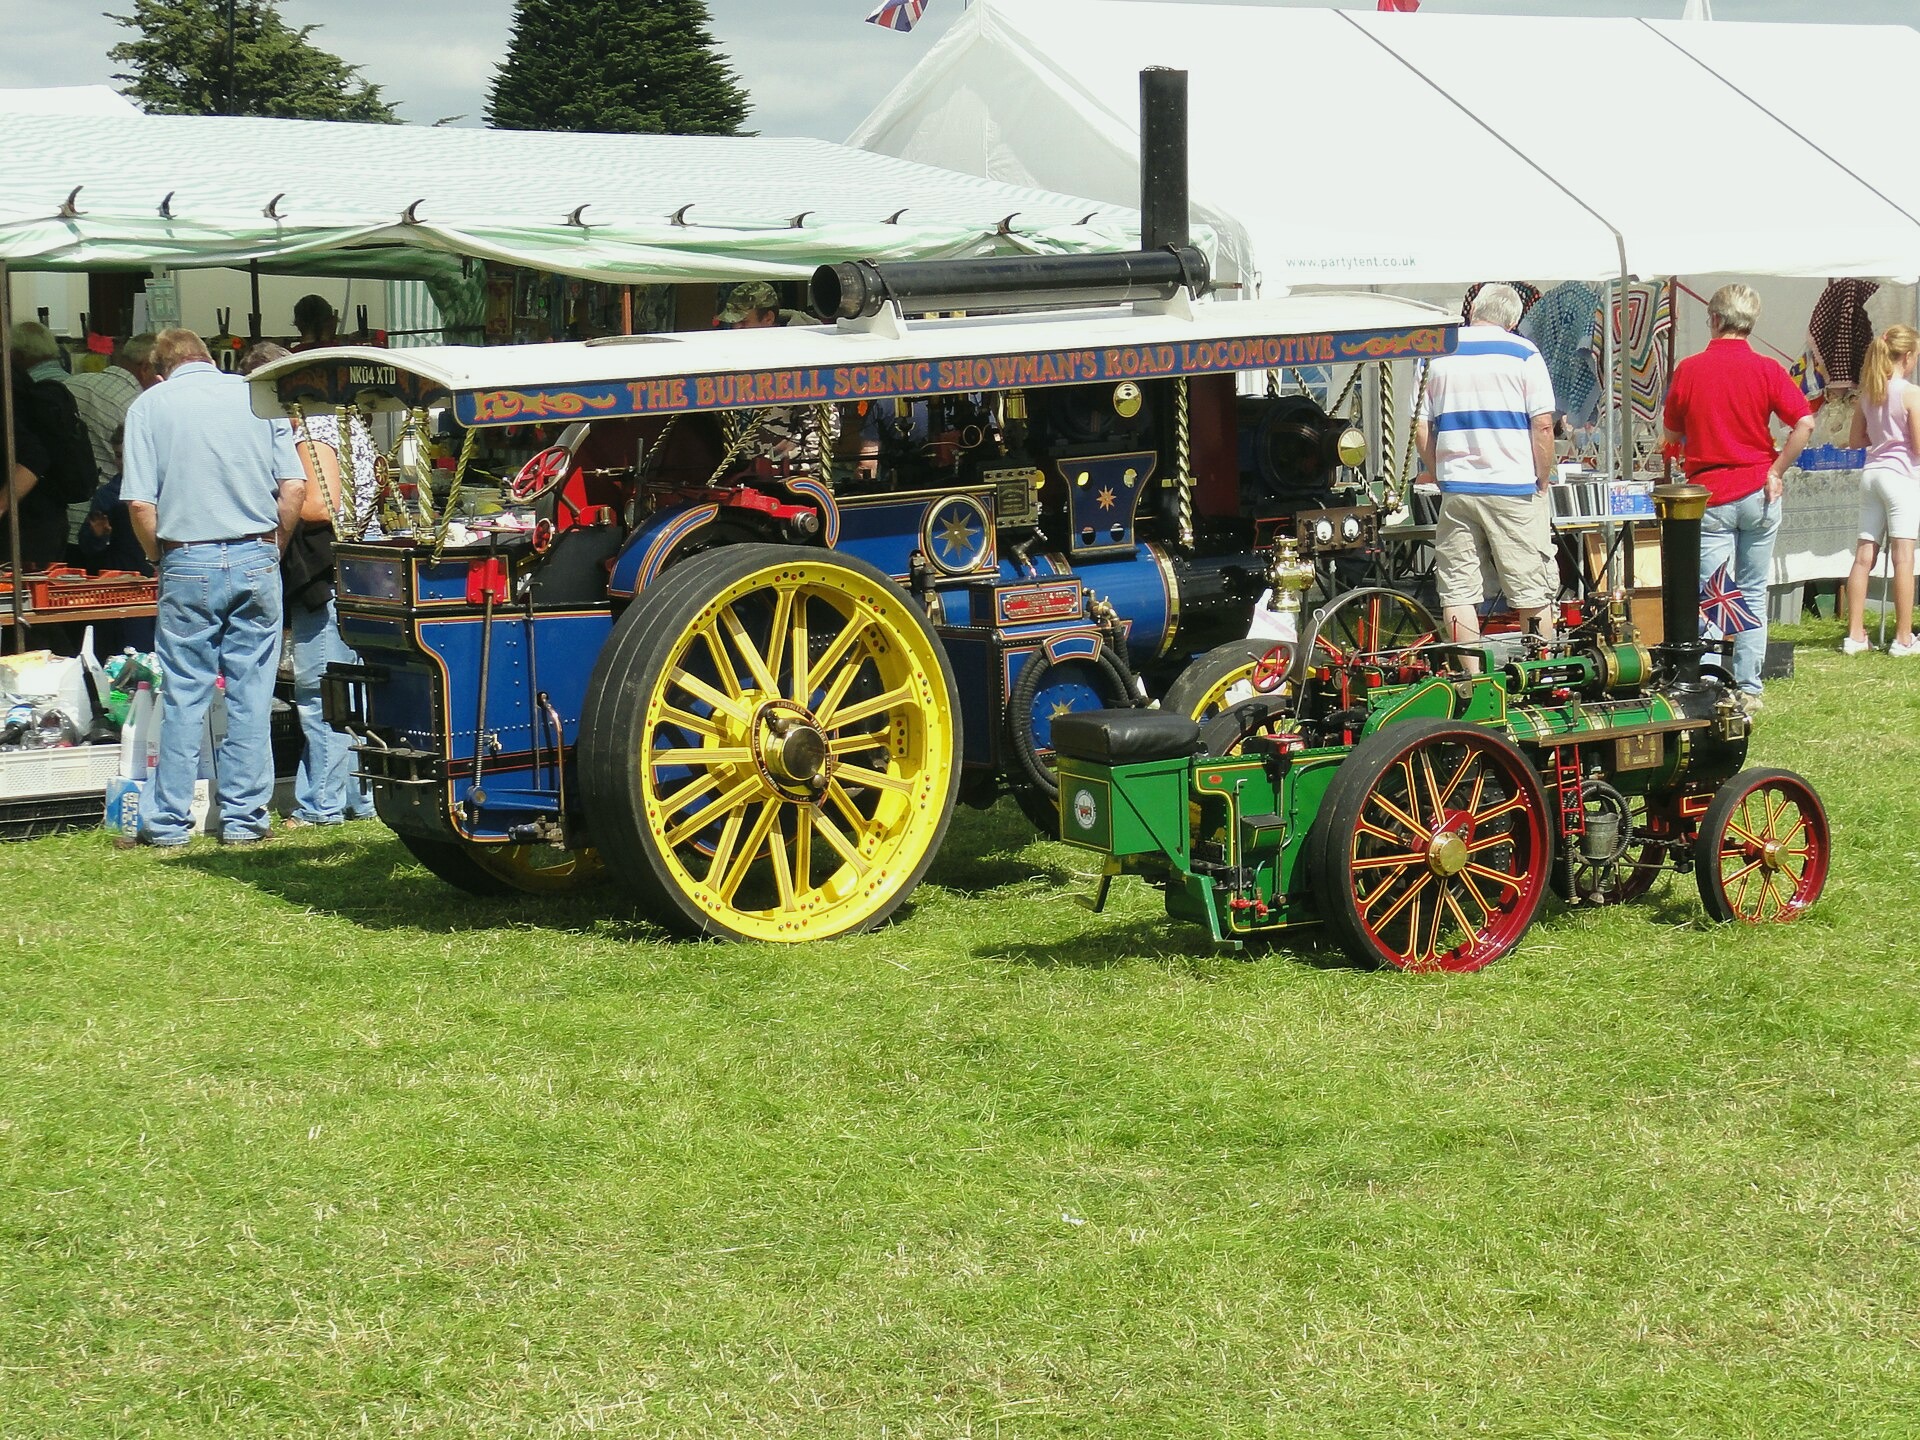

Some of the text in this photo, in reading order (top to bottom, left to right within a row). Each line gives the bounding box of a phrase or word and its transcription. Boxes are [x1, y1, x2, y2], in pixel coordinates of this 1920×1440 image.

[1285, 256, 1416, 270] www.partytent.co.uk
[349, 366, 396, 385] NK04 XTD
[627, 334, 1335, 410] THE BURRELL SCENIC SHOWMAN'S ROAD LOCOMOTIVE
